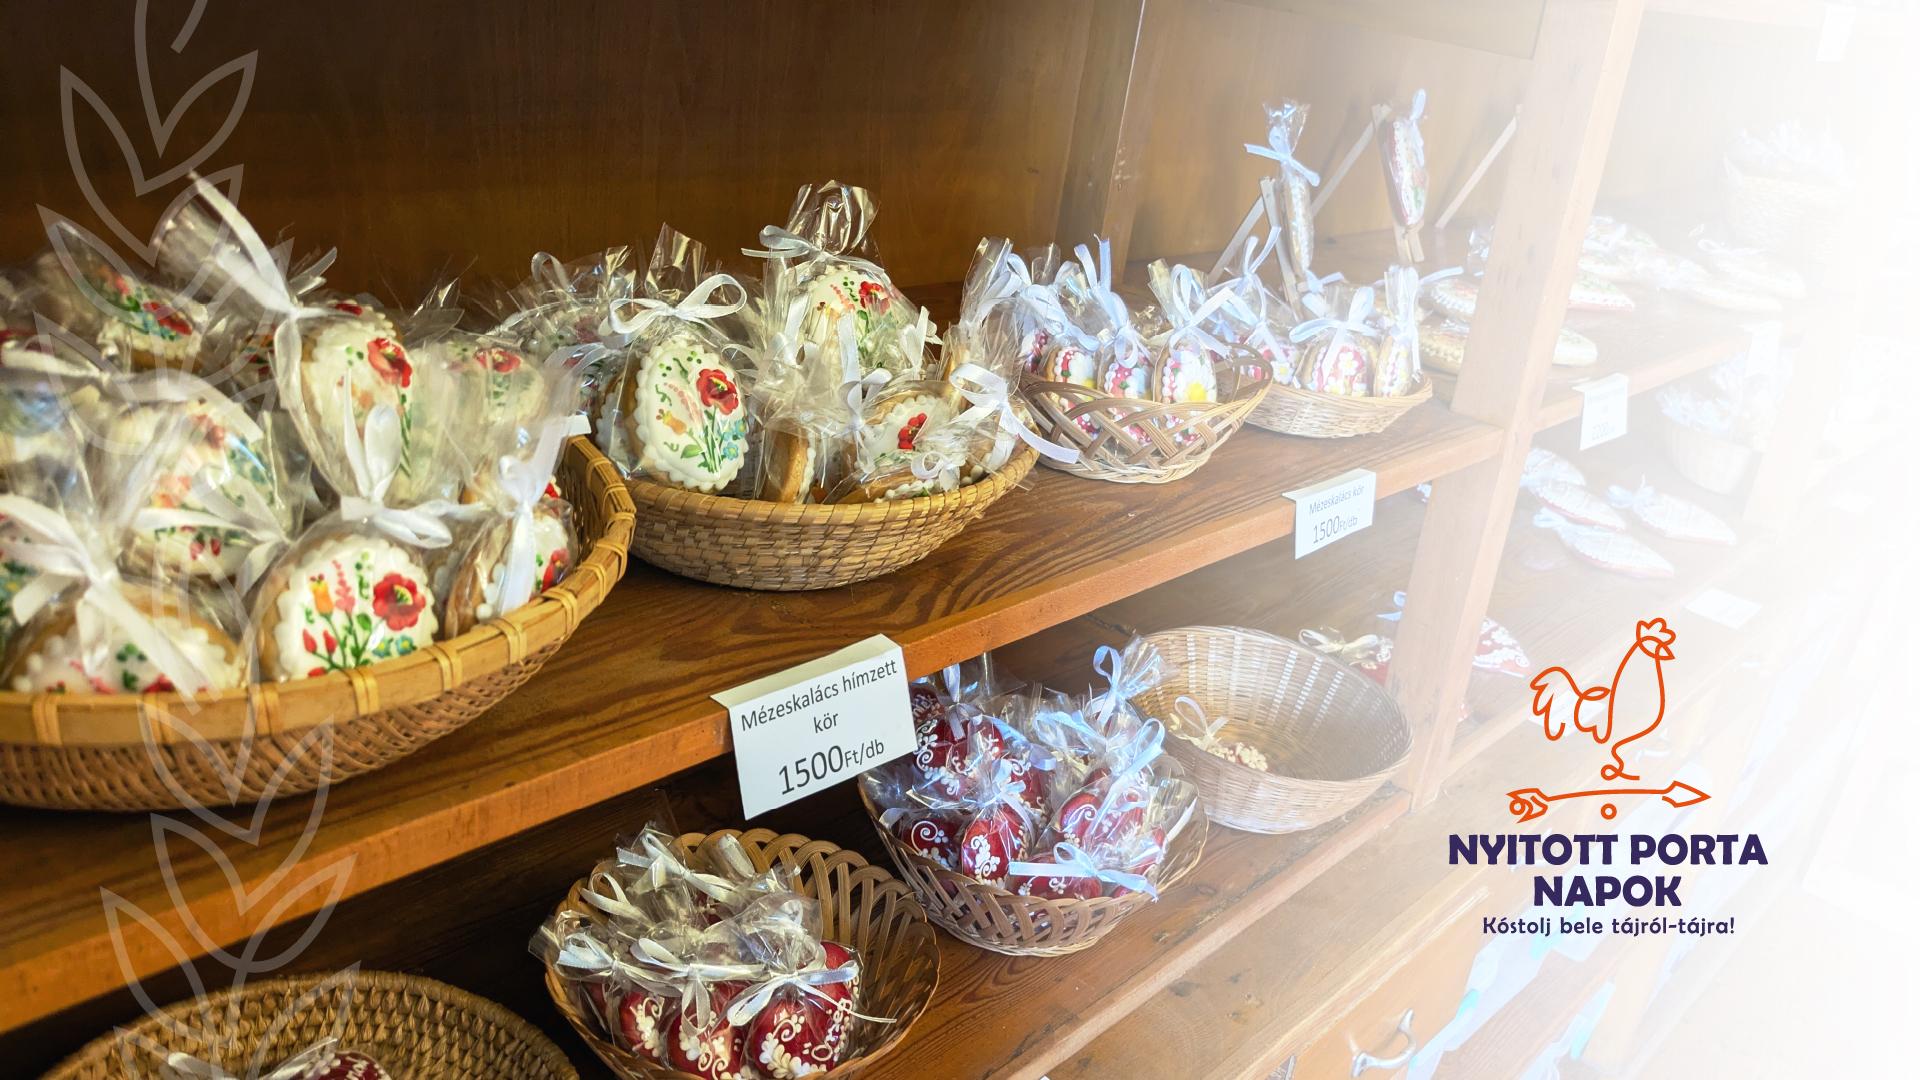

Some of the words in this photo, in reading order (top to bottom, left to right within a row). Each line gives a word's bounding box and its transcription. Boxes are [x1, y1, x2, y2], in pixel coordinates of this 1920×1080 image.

[740, 684, 839, 732] Mézeskalács
[842, 659, 898, 693] hímzett
[813, 713, 839, 734] kör
[778, 739, 885, 795] 1500Ft/db
